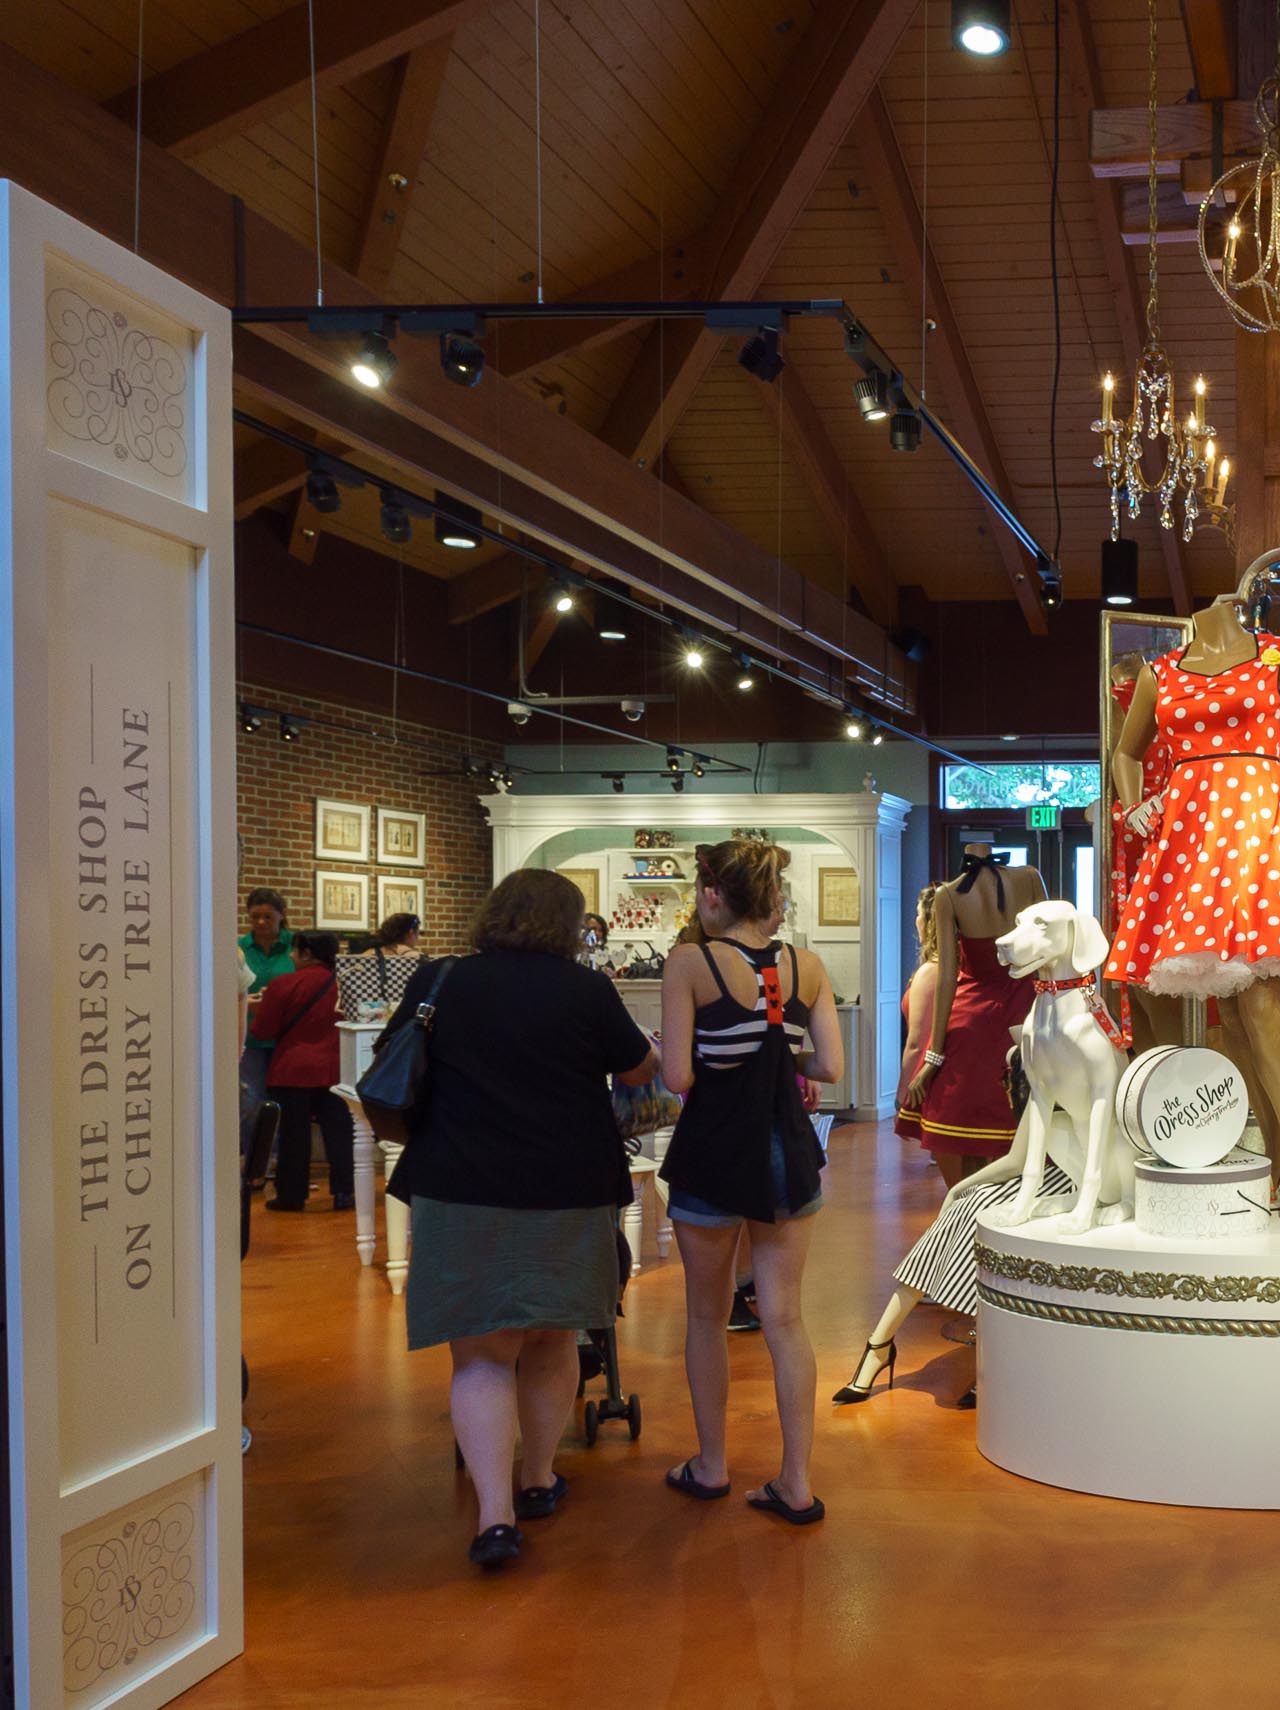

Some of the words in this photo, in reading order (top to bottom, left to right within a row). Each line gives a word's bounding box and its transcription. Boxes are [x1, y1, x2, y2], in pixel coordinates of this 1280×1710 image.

[122, 708, 149, 834] LANE
[1031, 807, 1057, 827] EXIT
[78, 786, 108, 914] SHOP
[123, 860, 151, 980] TREE
[79, 942, 109, 1095] DRESS
[124, 1004, 152, 1196] CHERRY
[1154, 1102, 1200, 1141] Dress
[1195, 1076, 1234, 1114] Shop
[1162, 1096, 1182, 1117] the
[80, 1120, 109, 1222] THE
[125, 1223, 152, 1291] ON
